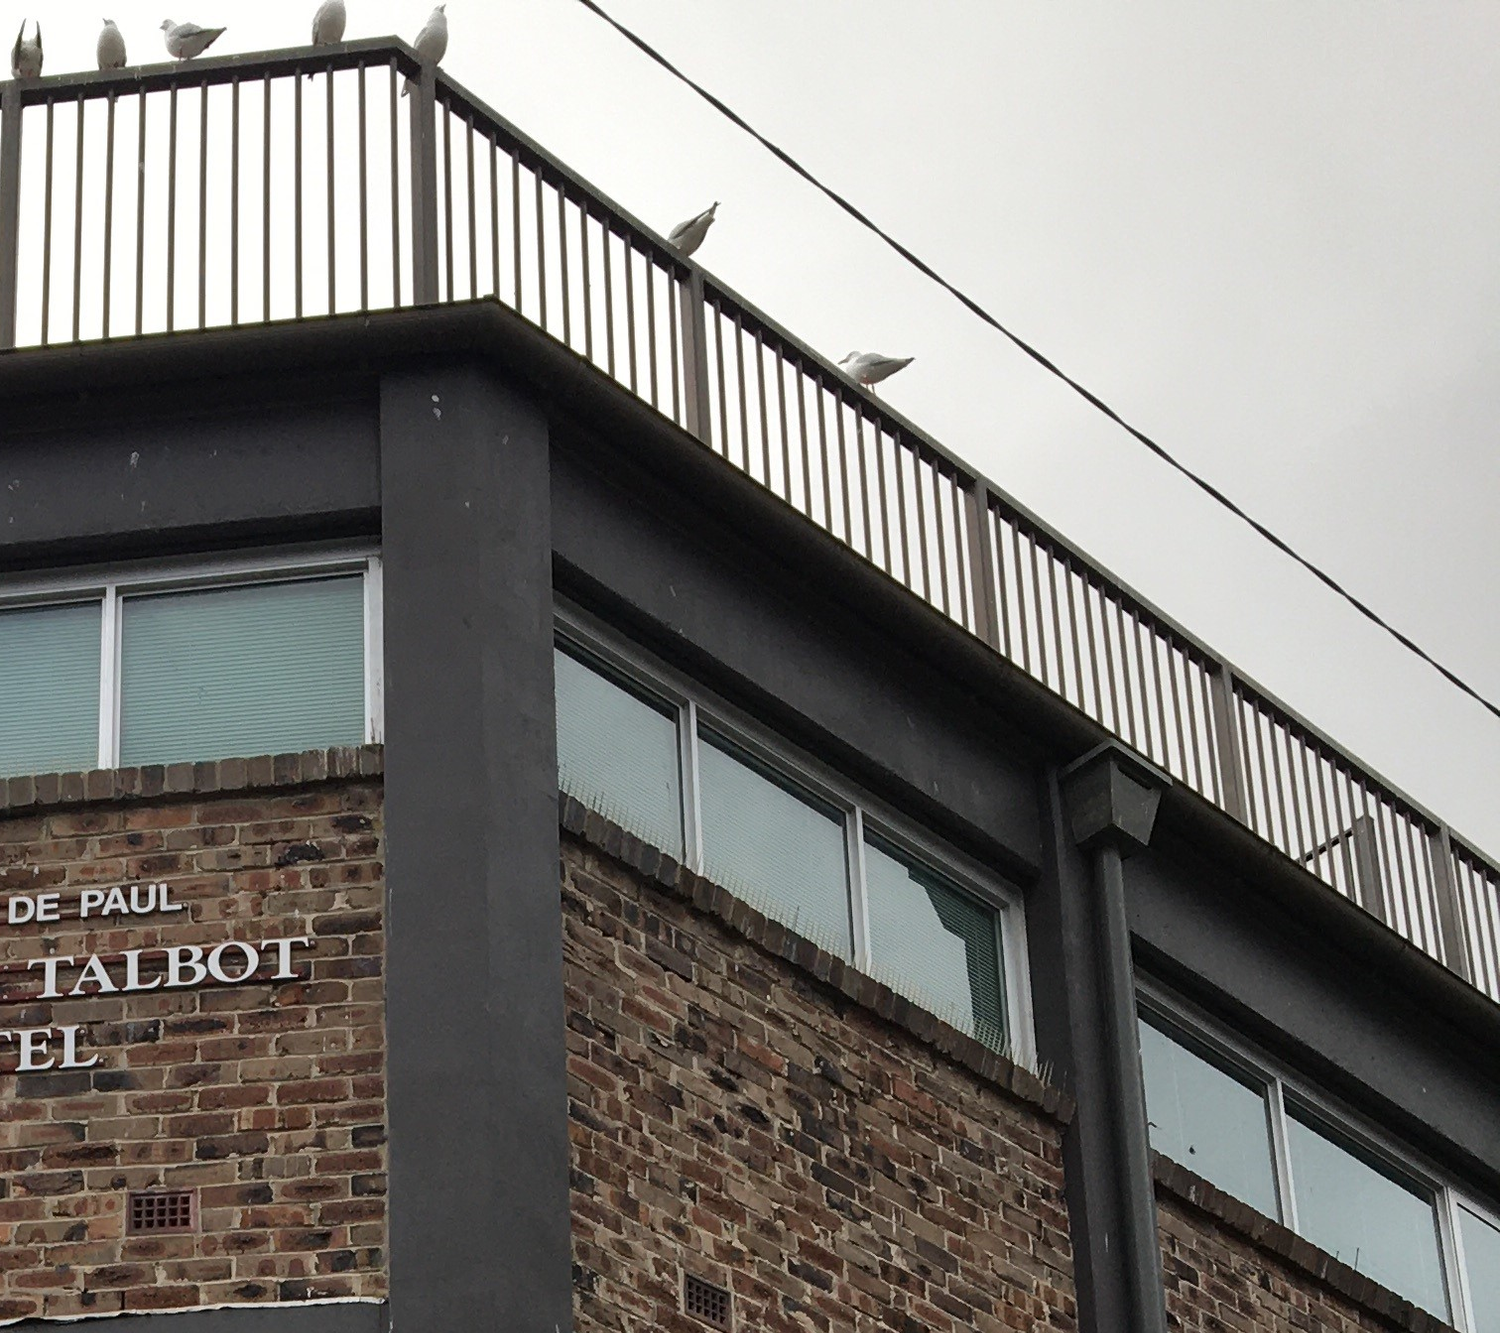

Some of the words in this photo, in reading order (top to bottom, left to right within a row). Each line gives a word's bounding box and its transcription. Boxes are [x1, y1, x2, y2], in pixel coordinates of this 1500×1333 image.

[7, 892, 61, 925] DE
[79, 883, 183, 918] PAUL
[26, 936, 310, 1000] TALBOT
